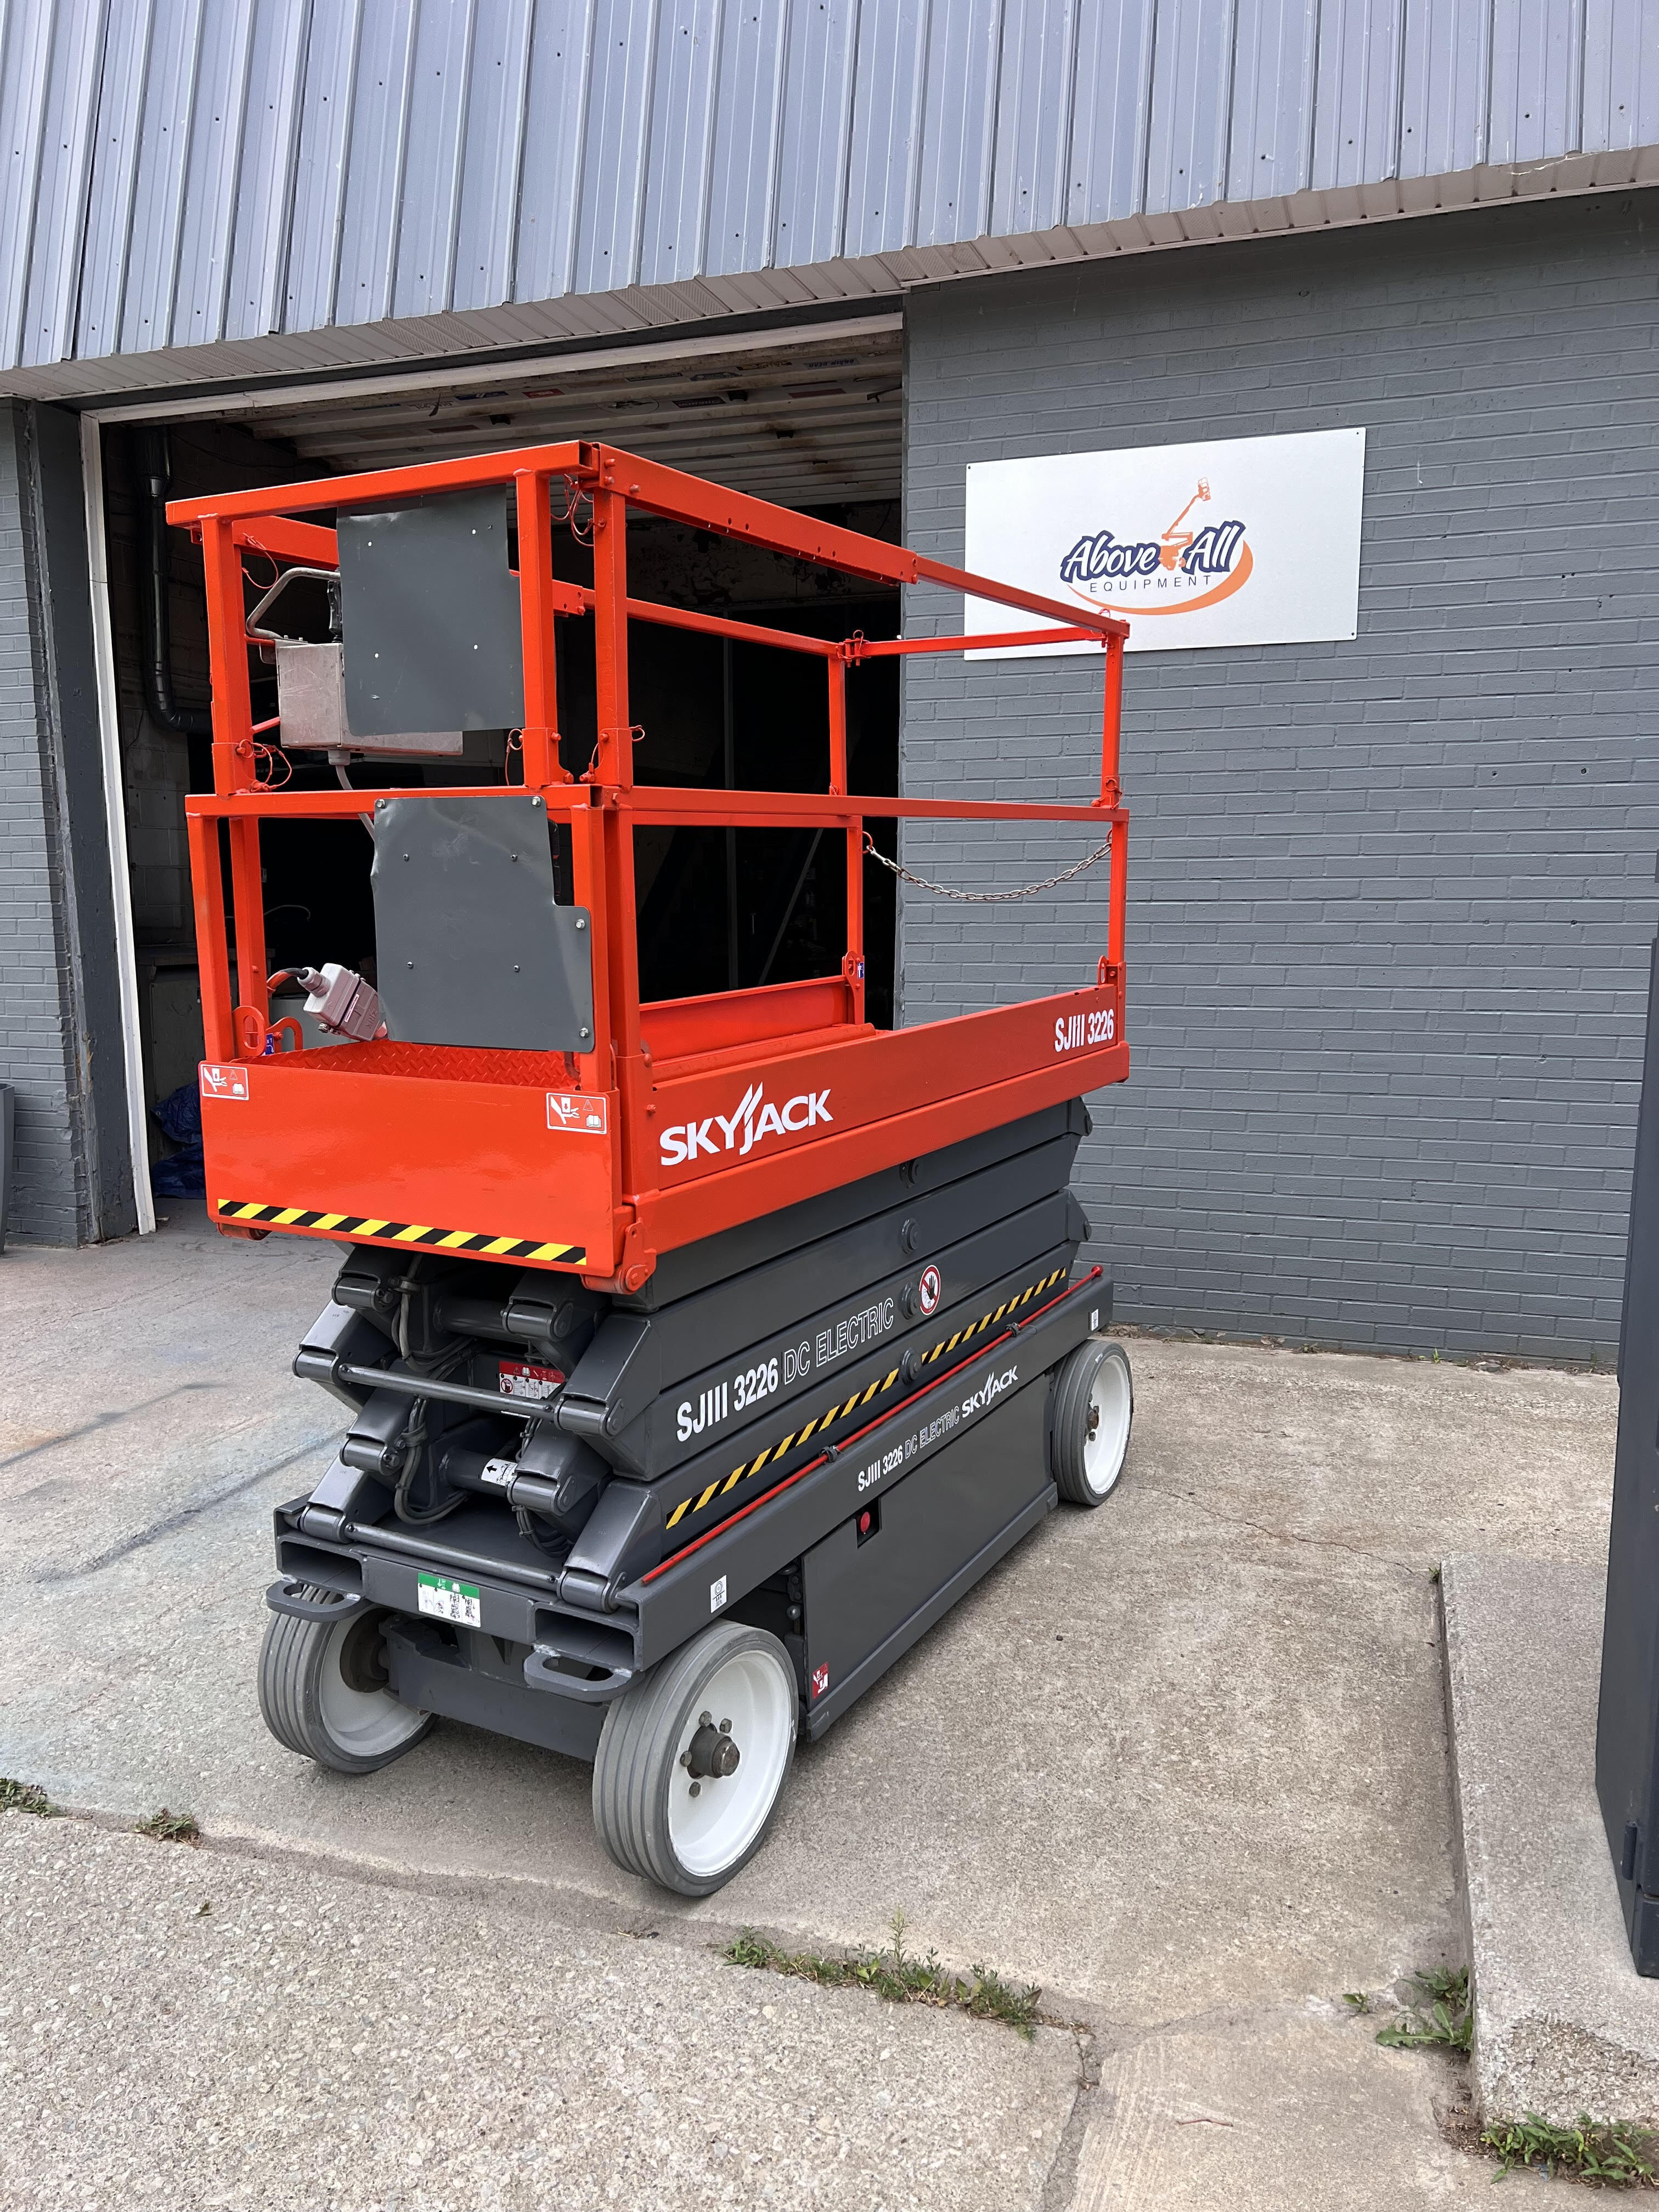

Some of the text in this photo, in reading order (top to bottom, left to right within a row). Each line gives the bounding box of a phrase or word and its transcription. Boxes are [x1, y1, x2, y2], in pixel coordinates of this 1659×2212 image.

[1061, 522, 1244, 582] Above All
[1090, 575, 1211, 593] EQUIPMENT
[1054, 1008, 1114, 1052] SJIII 3226
[659, 1081, 834, 1166] SKYJACK
[676, 1297, 894, 1442] SJIII 3226 DC ELECTRIC
[857, 1365, 1019, 1492] SJIII 3226 DC ELECTRIC SKYJACK
